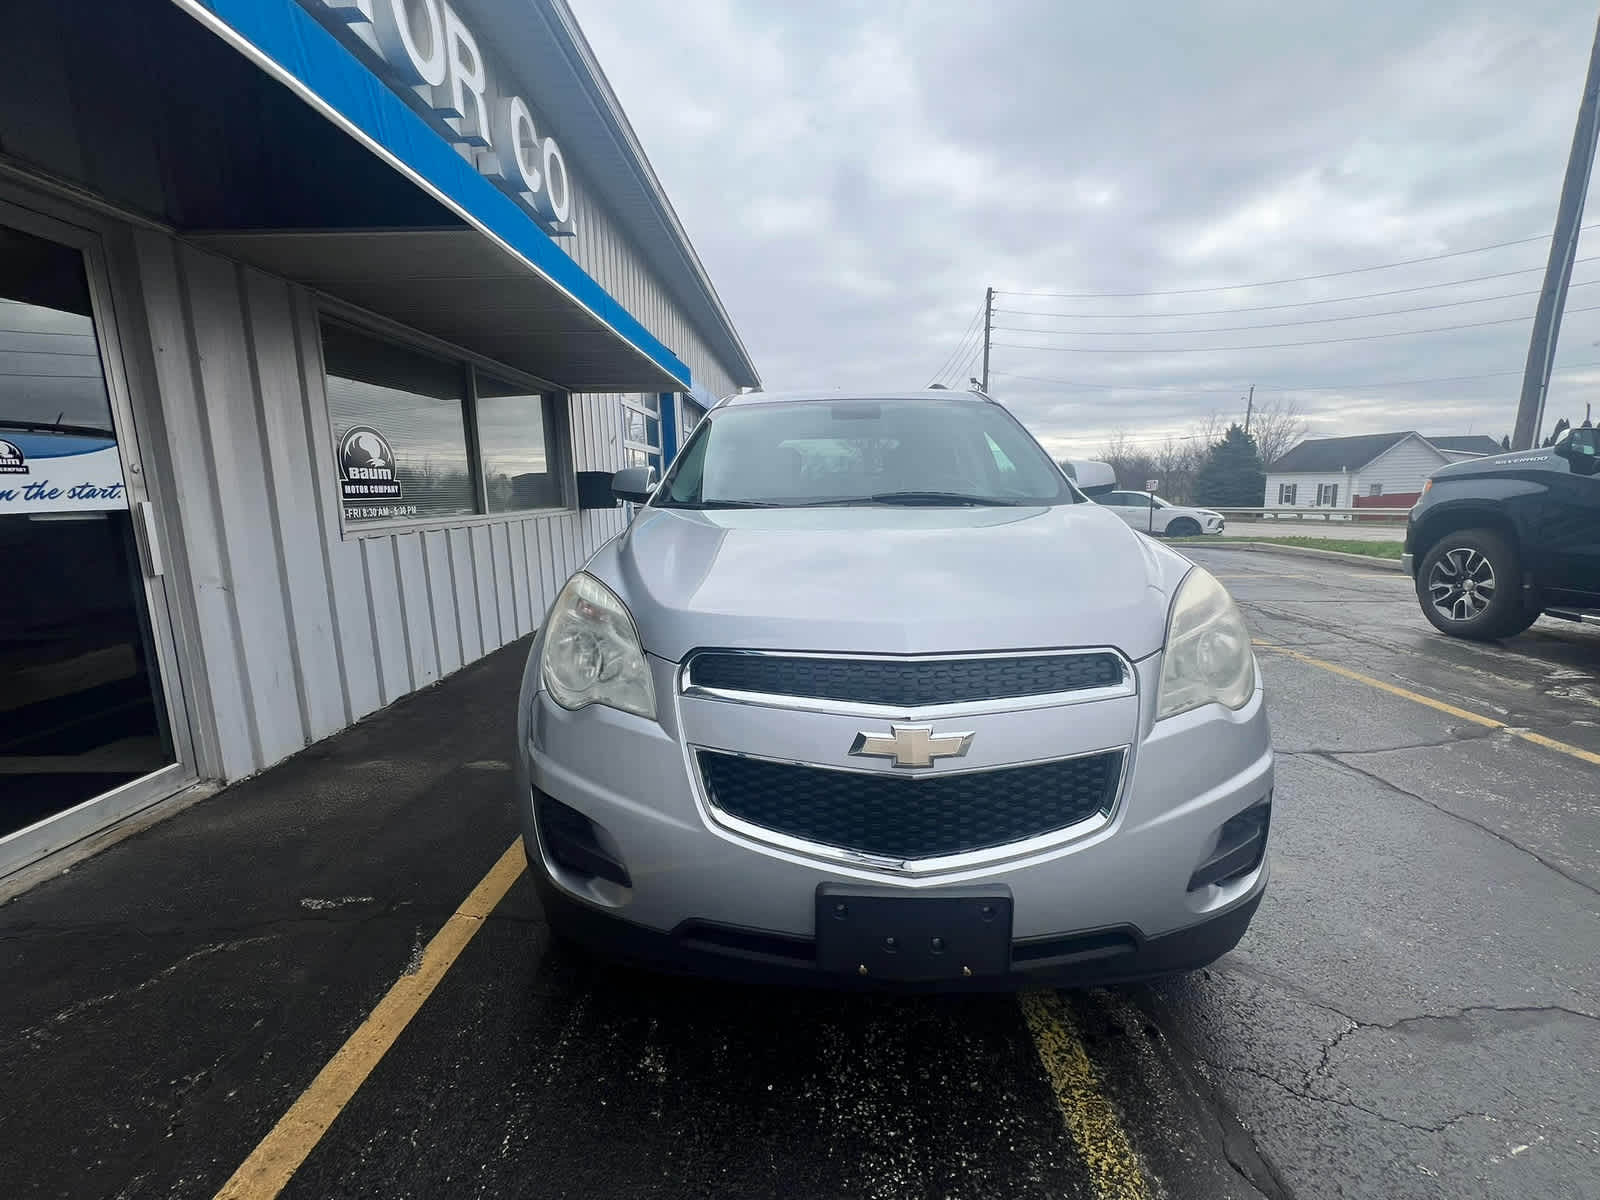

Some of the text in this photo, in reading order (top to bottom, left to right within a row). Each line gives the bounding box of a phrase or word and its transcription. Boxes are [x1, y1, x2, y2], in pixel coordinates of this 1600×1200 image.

[357, 0, 493, 148] OR
[348, 467, 392, 480] Baum
[21, 480, 63, 501] the
[66, 482, 124, 500] start.
[344, 485, 398, 494] MOTOR COMPANY
[363, 507, 377, 517] 8:30
[378, 507, 389, 516] AM
